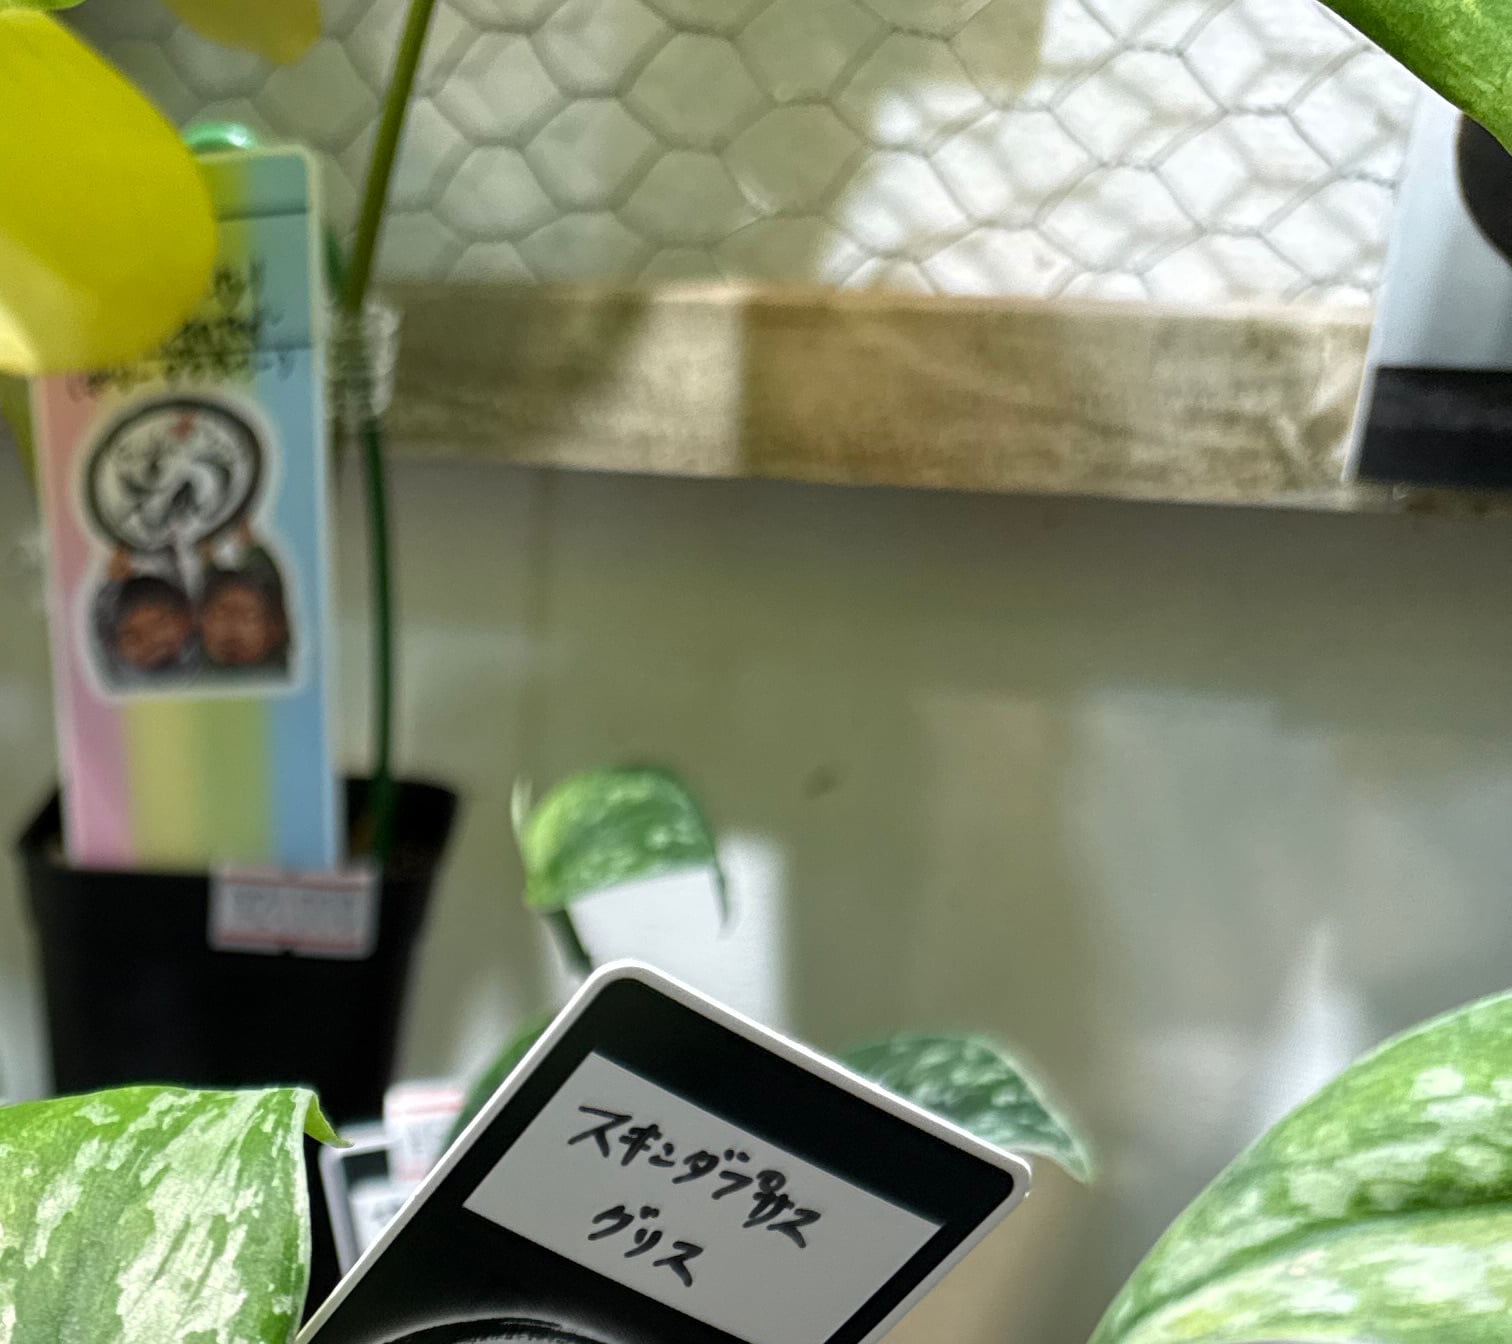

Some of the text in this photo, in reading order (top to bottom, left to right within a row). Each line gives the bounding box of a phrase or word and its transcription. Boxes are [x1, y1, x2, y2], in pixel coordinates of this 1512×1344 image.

[567, 1105, 822, 1248] スキンダプサス
[587, 1204, 704, 1288] グリス
